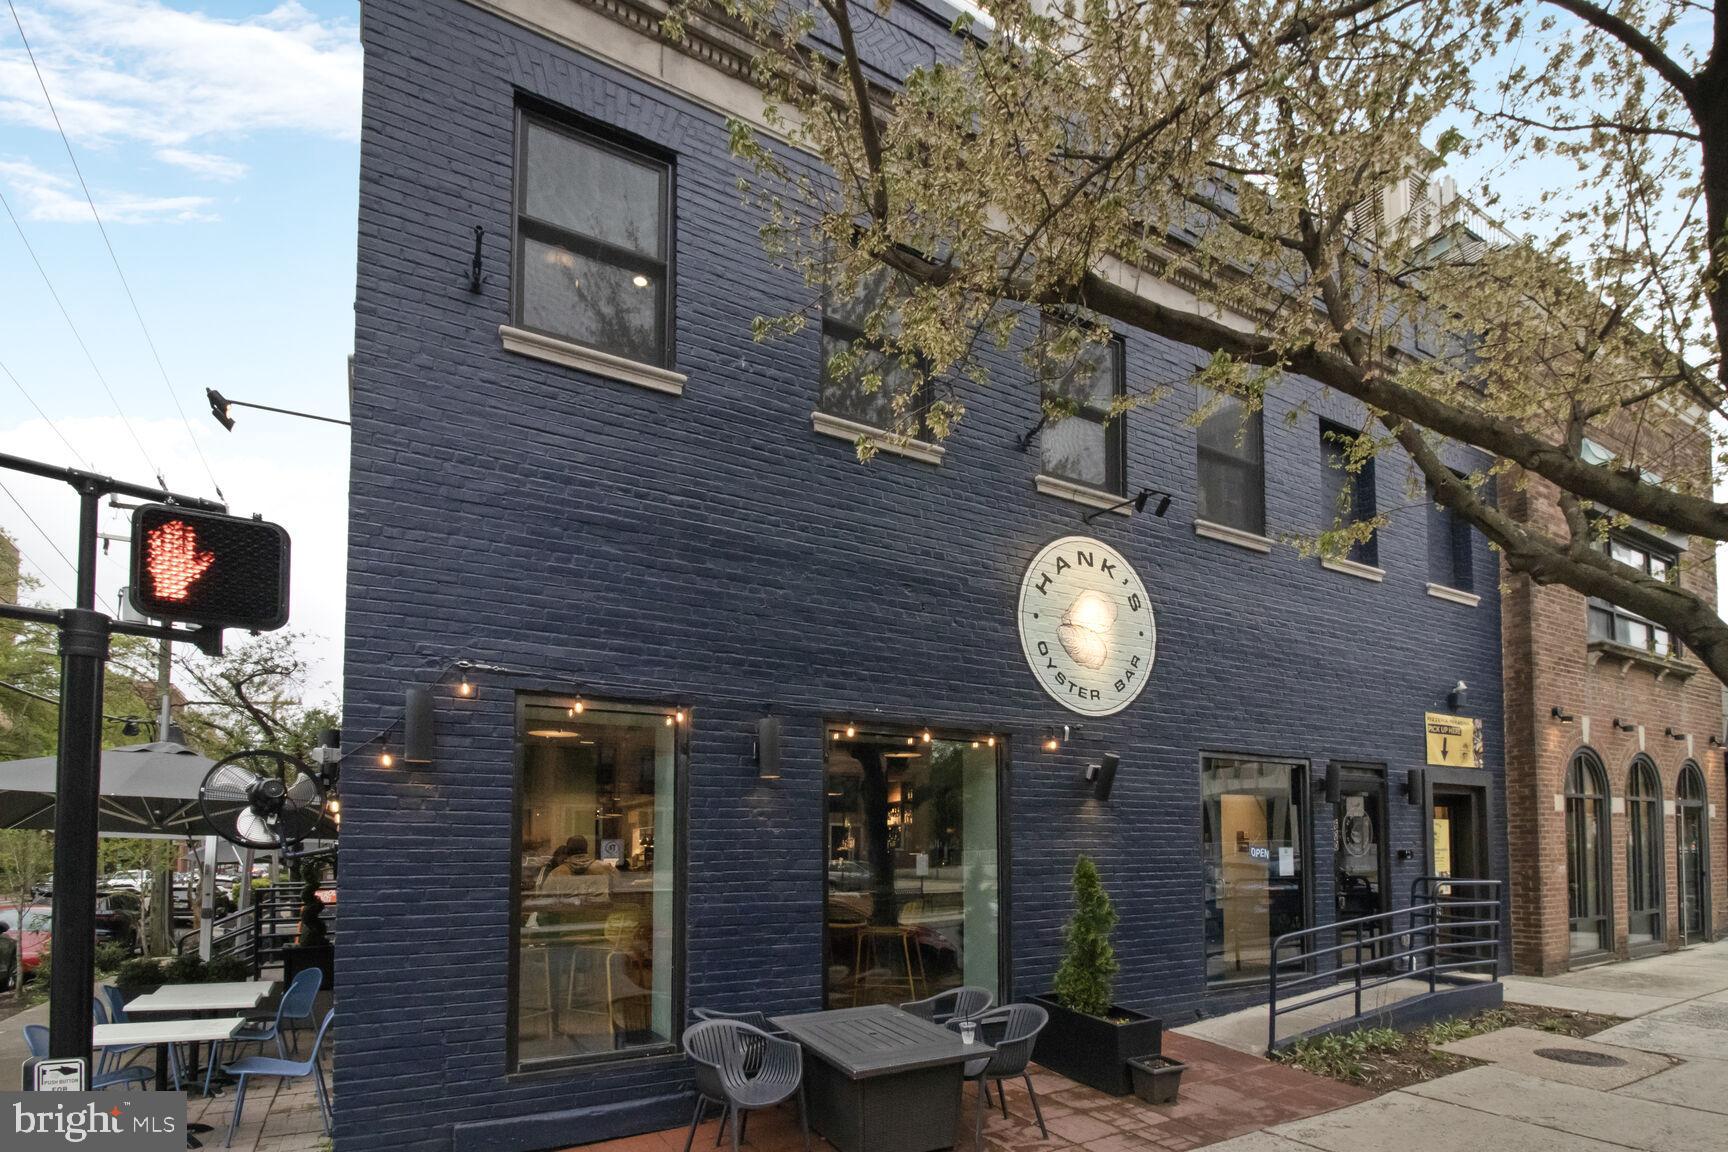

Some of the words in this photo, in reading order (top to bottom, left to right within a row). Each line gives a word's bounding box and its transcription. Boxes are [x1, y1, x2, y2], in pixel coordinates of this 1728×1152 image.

[1036, 551, 1141, 612] HANK'S
[1037, 641, 1100, 700] OYSTER
[1114, 655, 1140, 692] BAR
[1428, 725, 1440, 733] PICK
[1448, 727, 1460, 735] HERE
[1251, 847, 1269, 858] OPEN
